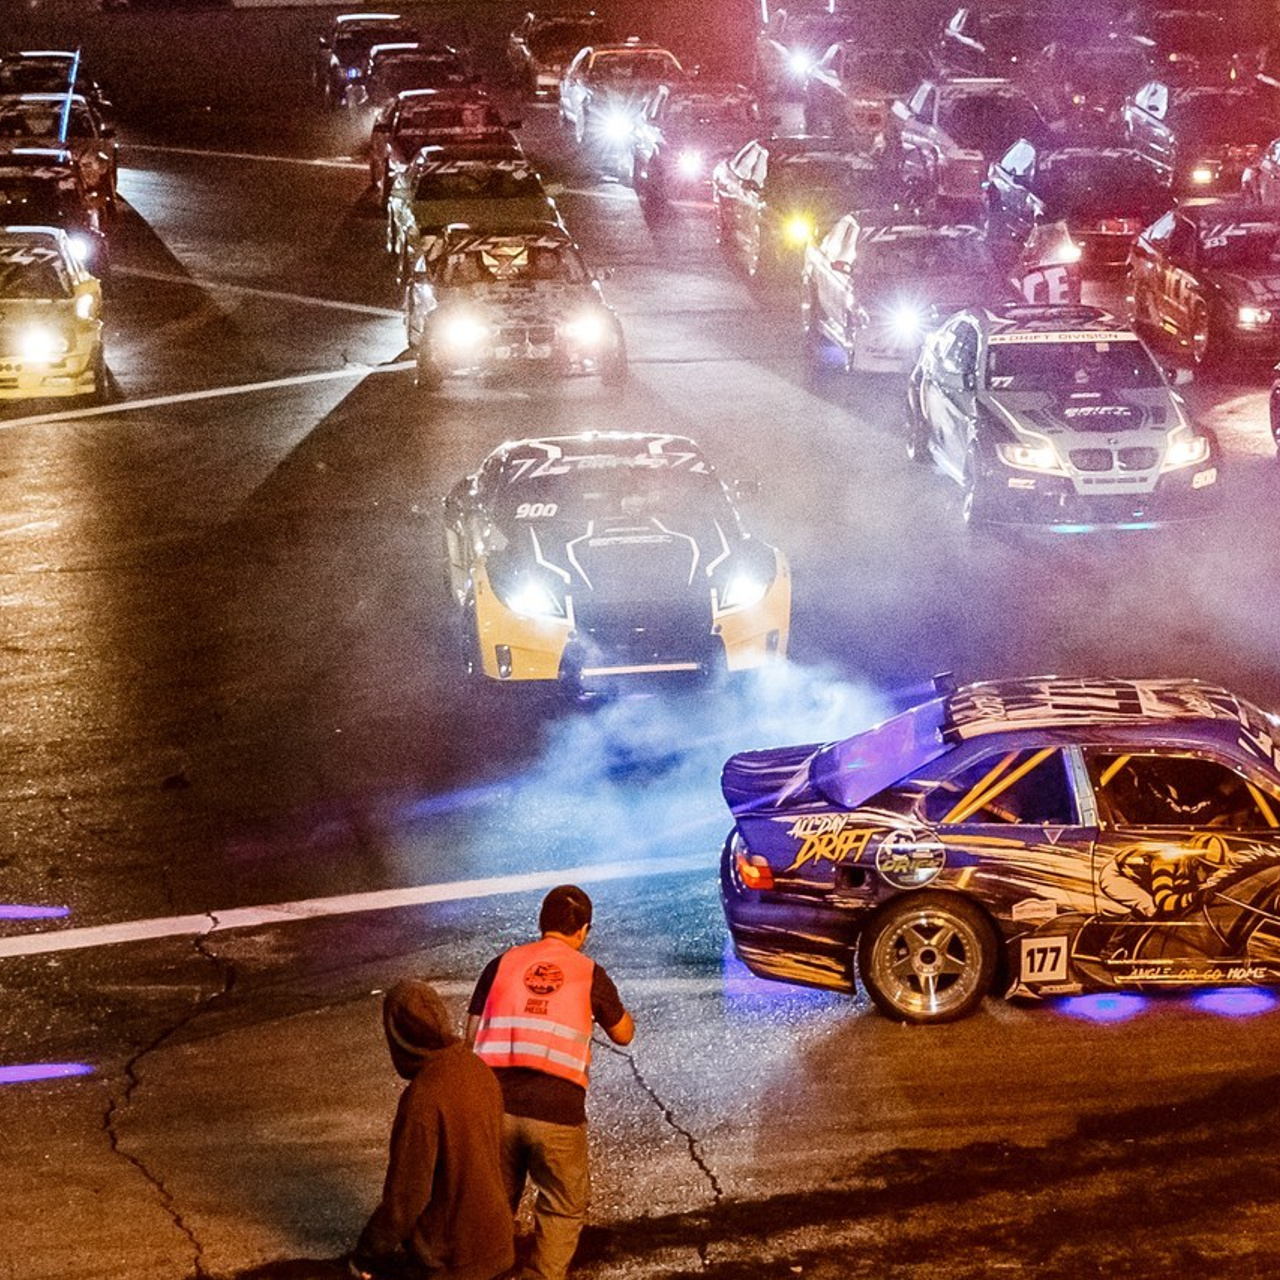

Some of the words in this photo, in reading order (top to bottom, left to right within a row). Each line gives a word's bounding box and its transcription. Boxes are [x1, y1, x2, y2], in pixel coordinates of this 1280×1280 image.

[1058, 332, 1119, 341] DIVISION
[514, 503, 558, 519] 900
[787, 816, 819, 839] ALL
[816, 814, 849, 836] DAY
[785, 828, 886, 873] DRIFT
[1026, 946, 1062, 974] 177
[1203, 969, 1222, 980] GO
[1227, 966, 1268, 980] HOME
